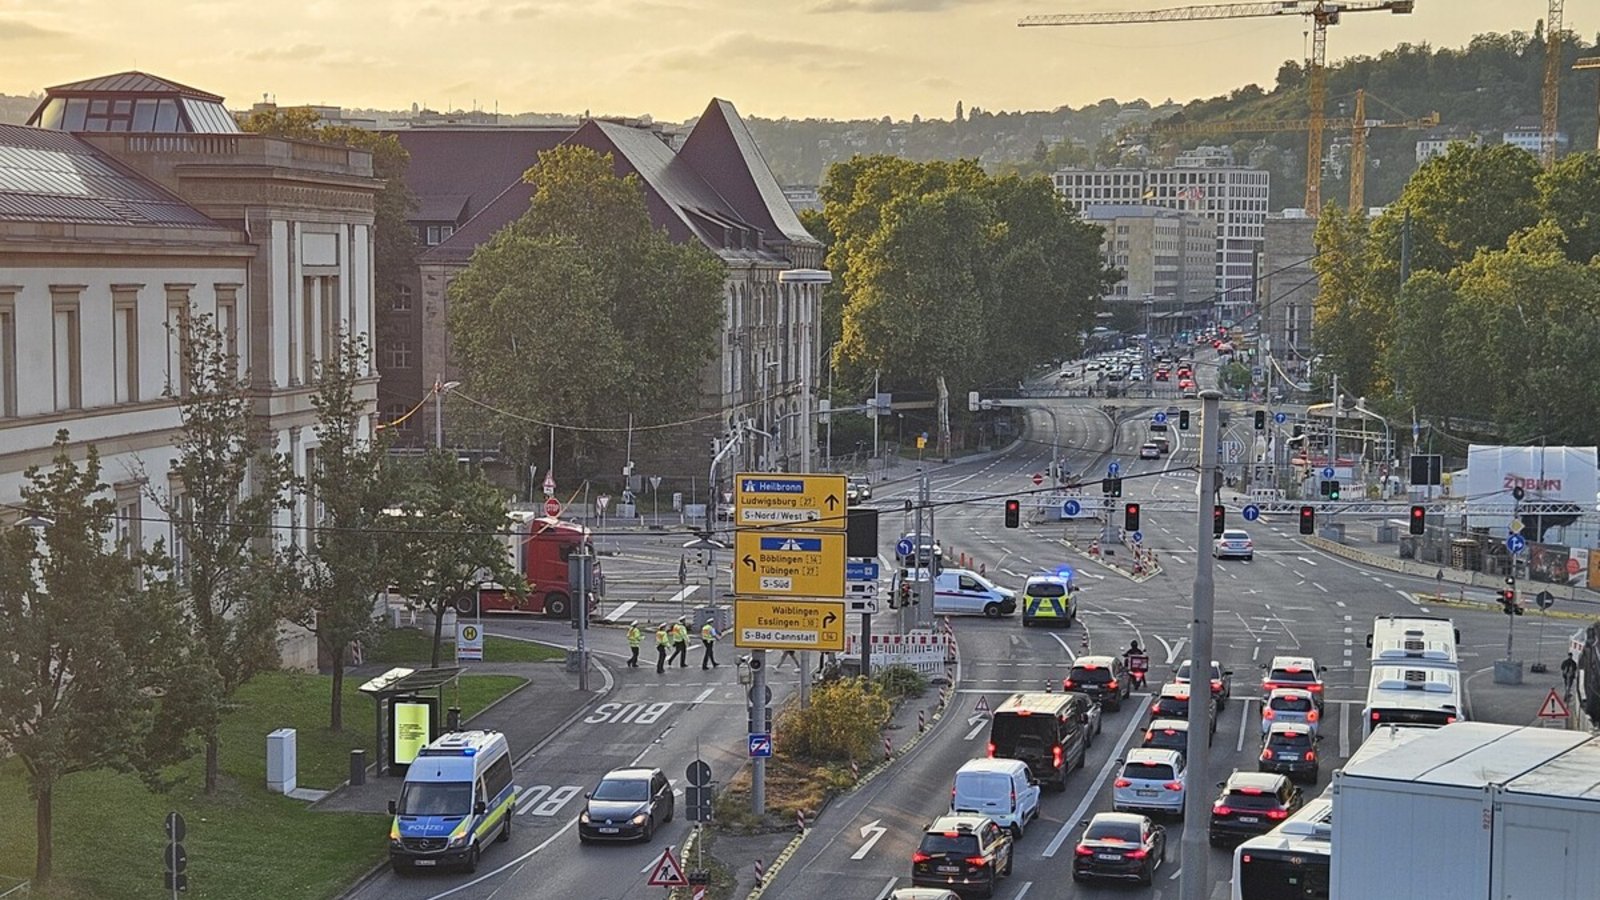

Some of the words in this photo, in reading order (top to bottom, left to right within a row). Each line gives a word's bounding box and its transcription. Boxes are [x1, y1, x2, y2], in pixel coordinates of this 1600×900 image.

[759, 481, 802, 491] Heilbronn
[547, 503, 559, 512] STOP
[741, 496, 797, 508] Ludwigsburg
[760, 554, 803, 565] Böblingen
[760, 566, 799, 577] Tübingen
[763, 579, 790, 589] S-Süd
[772, 606, 819, 617] Waiblingen
[757, 617, 799, 628] Esslingen
[744, 630, 772, 640] S-Bad
[774, 631, 816, 642] Cannstatt
[583, 702, 674, 724] BUS
[407, 824, 444, 832] POLIZEI
